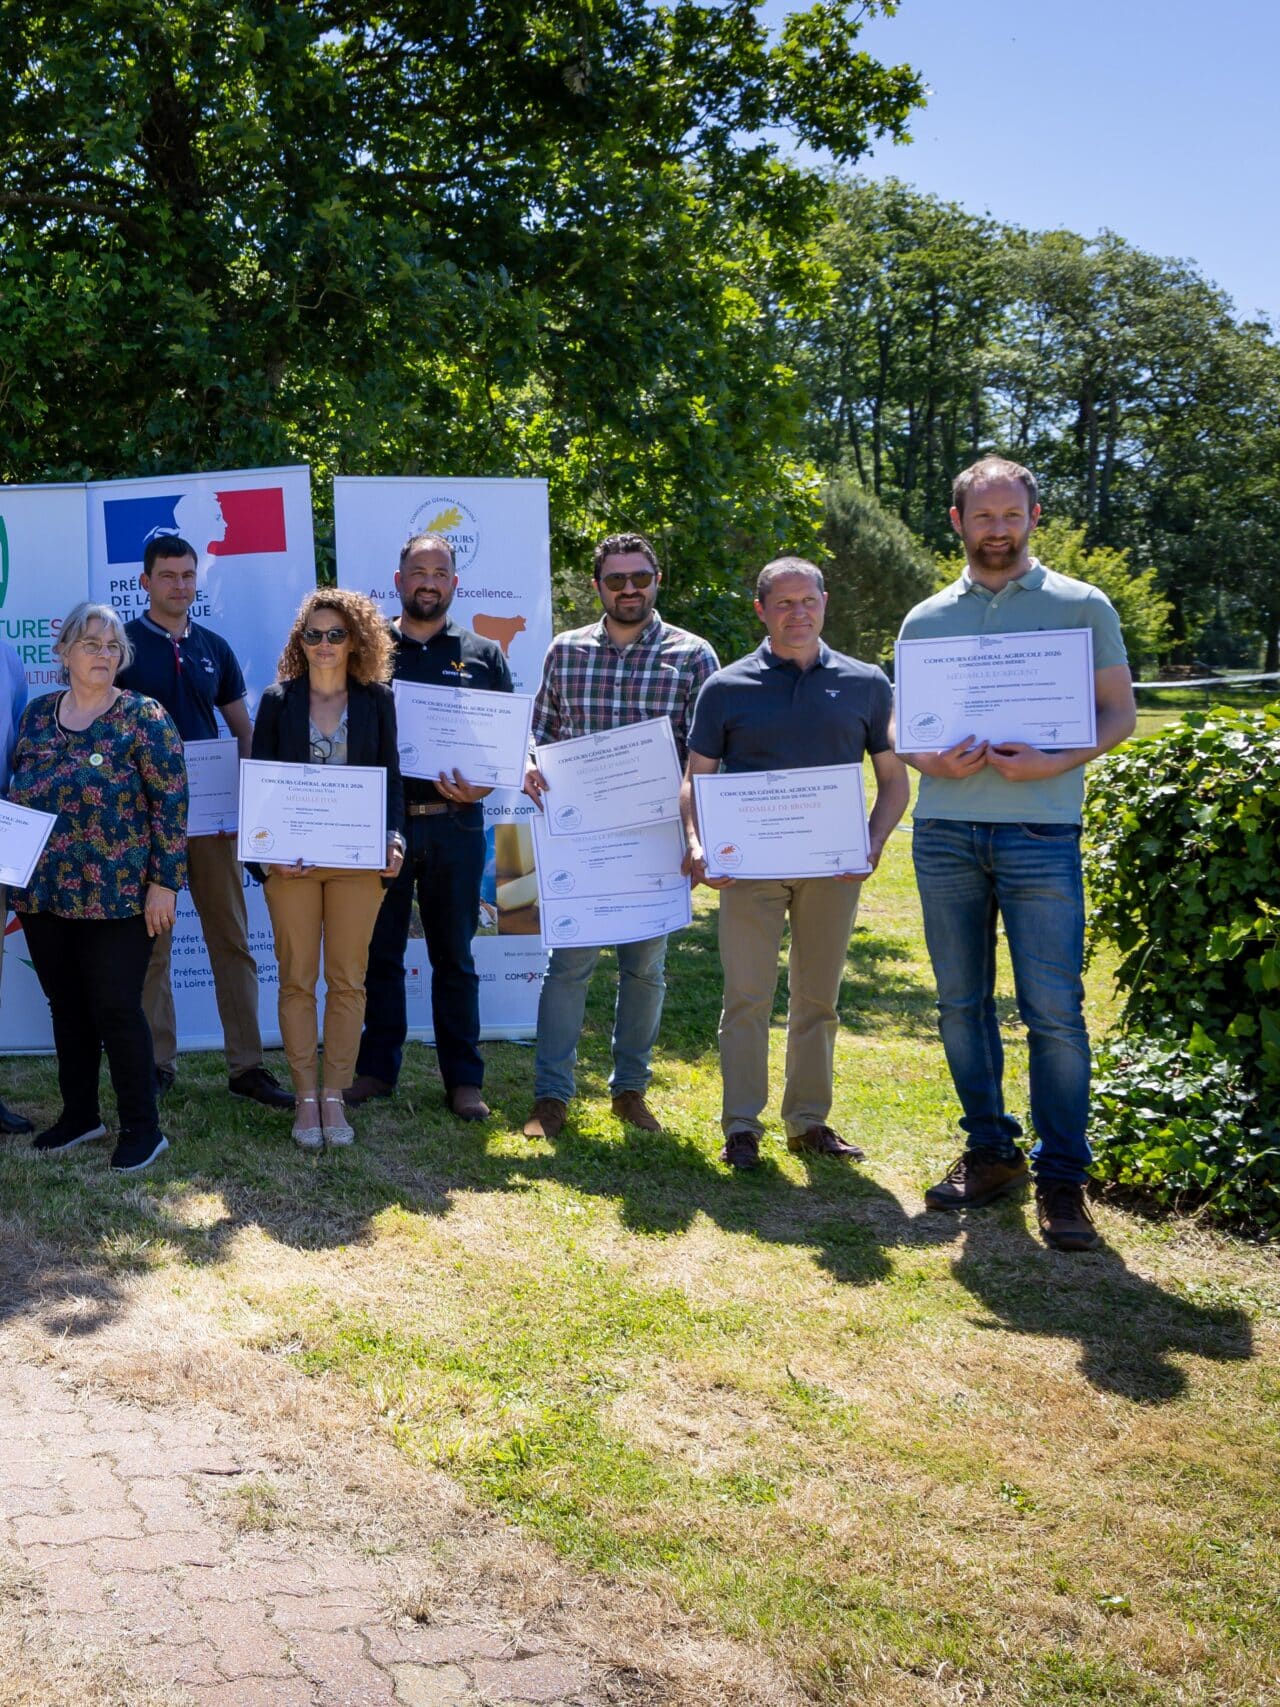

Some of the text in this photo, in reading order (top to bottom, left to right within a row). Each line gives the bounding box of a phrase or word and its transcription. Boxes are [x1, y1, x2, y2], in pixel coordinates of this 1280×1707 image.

[370, 589, 385, 599] Au
[111, 595, 131, 607] DE
[924, 650, 1062, 664] CONCOURS GÉNÉRAL AGRICOLE 2026
[412, 698, 443, 708] CONCOURS
[558, 752, 588, 765] CONCOURS
[613, 740, 640, 753] AGRICOLE
[261, 777, 364, 790] CONCOURS GÉNÉRAL AGRICOLE 2026
[720, 784, 838, 798] CONCOURS GÉNÉRAL AGRICOLE 2026
[778, 803, 789, 812] DE
[791, 801, 822, 811] BRONZE
[172, 945, 207, 956] et de la
[173, 964, 277, 977] Préfectu gion
[174, 980, 182, 989] la
[184, 979, 206, 988] Loire
